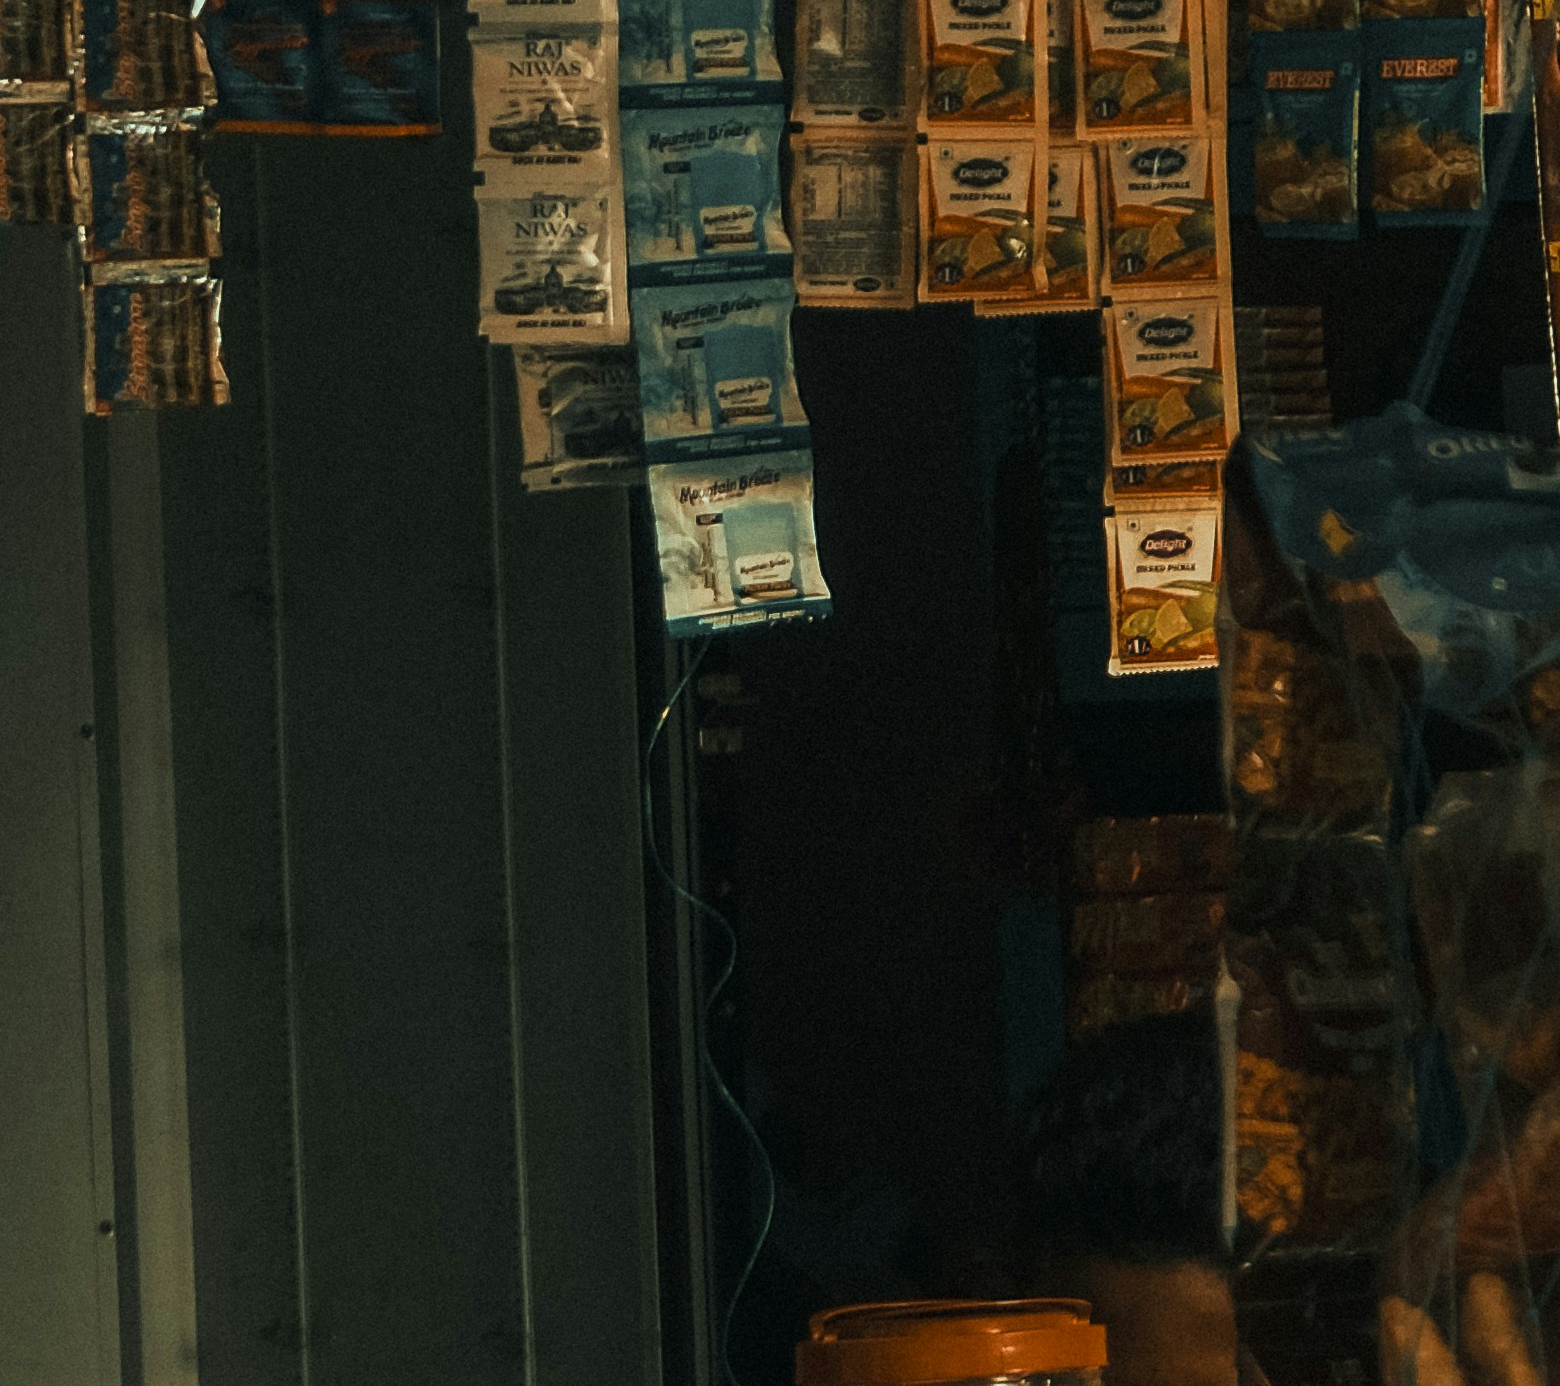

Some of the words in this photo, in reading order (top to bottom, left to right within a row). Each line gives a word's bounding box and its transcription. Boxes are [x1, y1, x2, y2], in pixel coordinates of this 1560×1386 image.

[525, 42, 562, 57] RAJ
[510, 61, 582, 78] NIWAS
[1382, 58, 1458, 78] EVEREST
